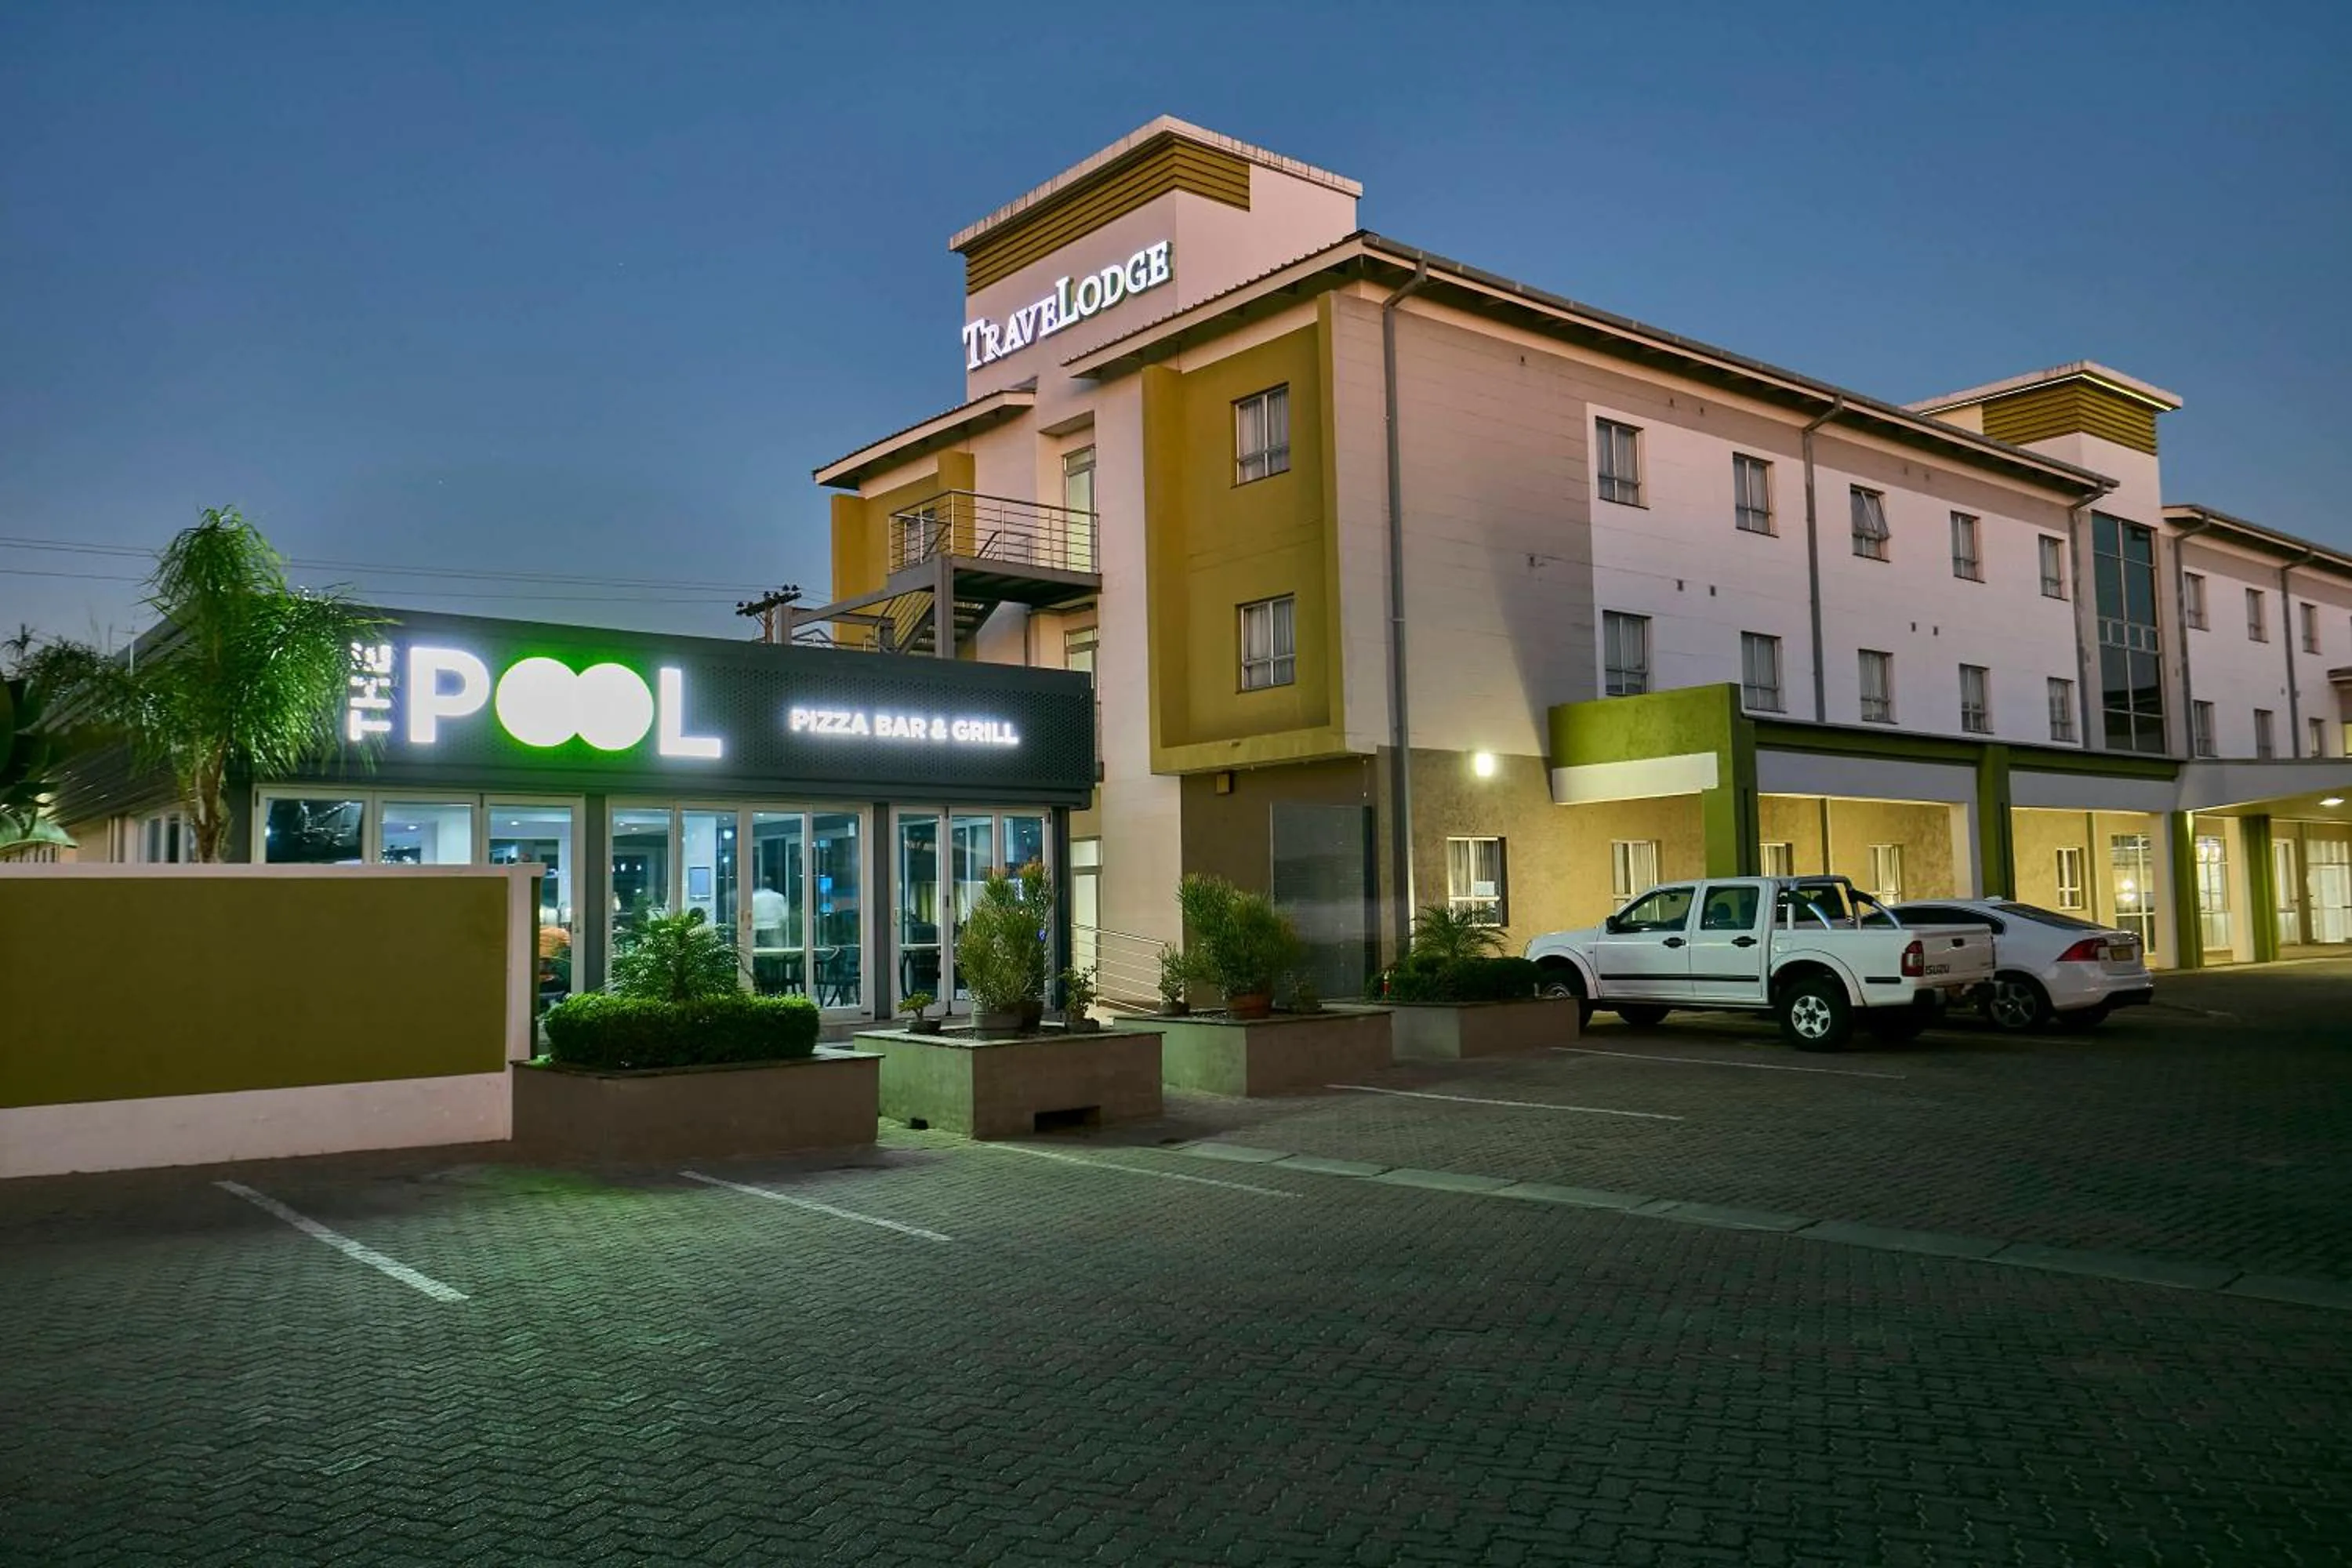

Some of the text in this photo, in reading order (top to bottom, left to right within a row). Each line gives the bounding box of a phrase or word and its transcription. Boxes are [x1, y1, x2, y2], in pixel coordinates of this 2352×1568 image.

[350, 642, 392, 741] THE
[409, 646, 722, 758] POOL
[790, 709, 1019, 744] PIZZA BAR & GRILL
